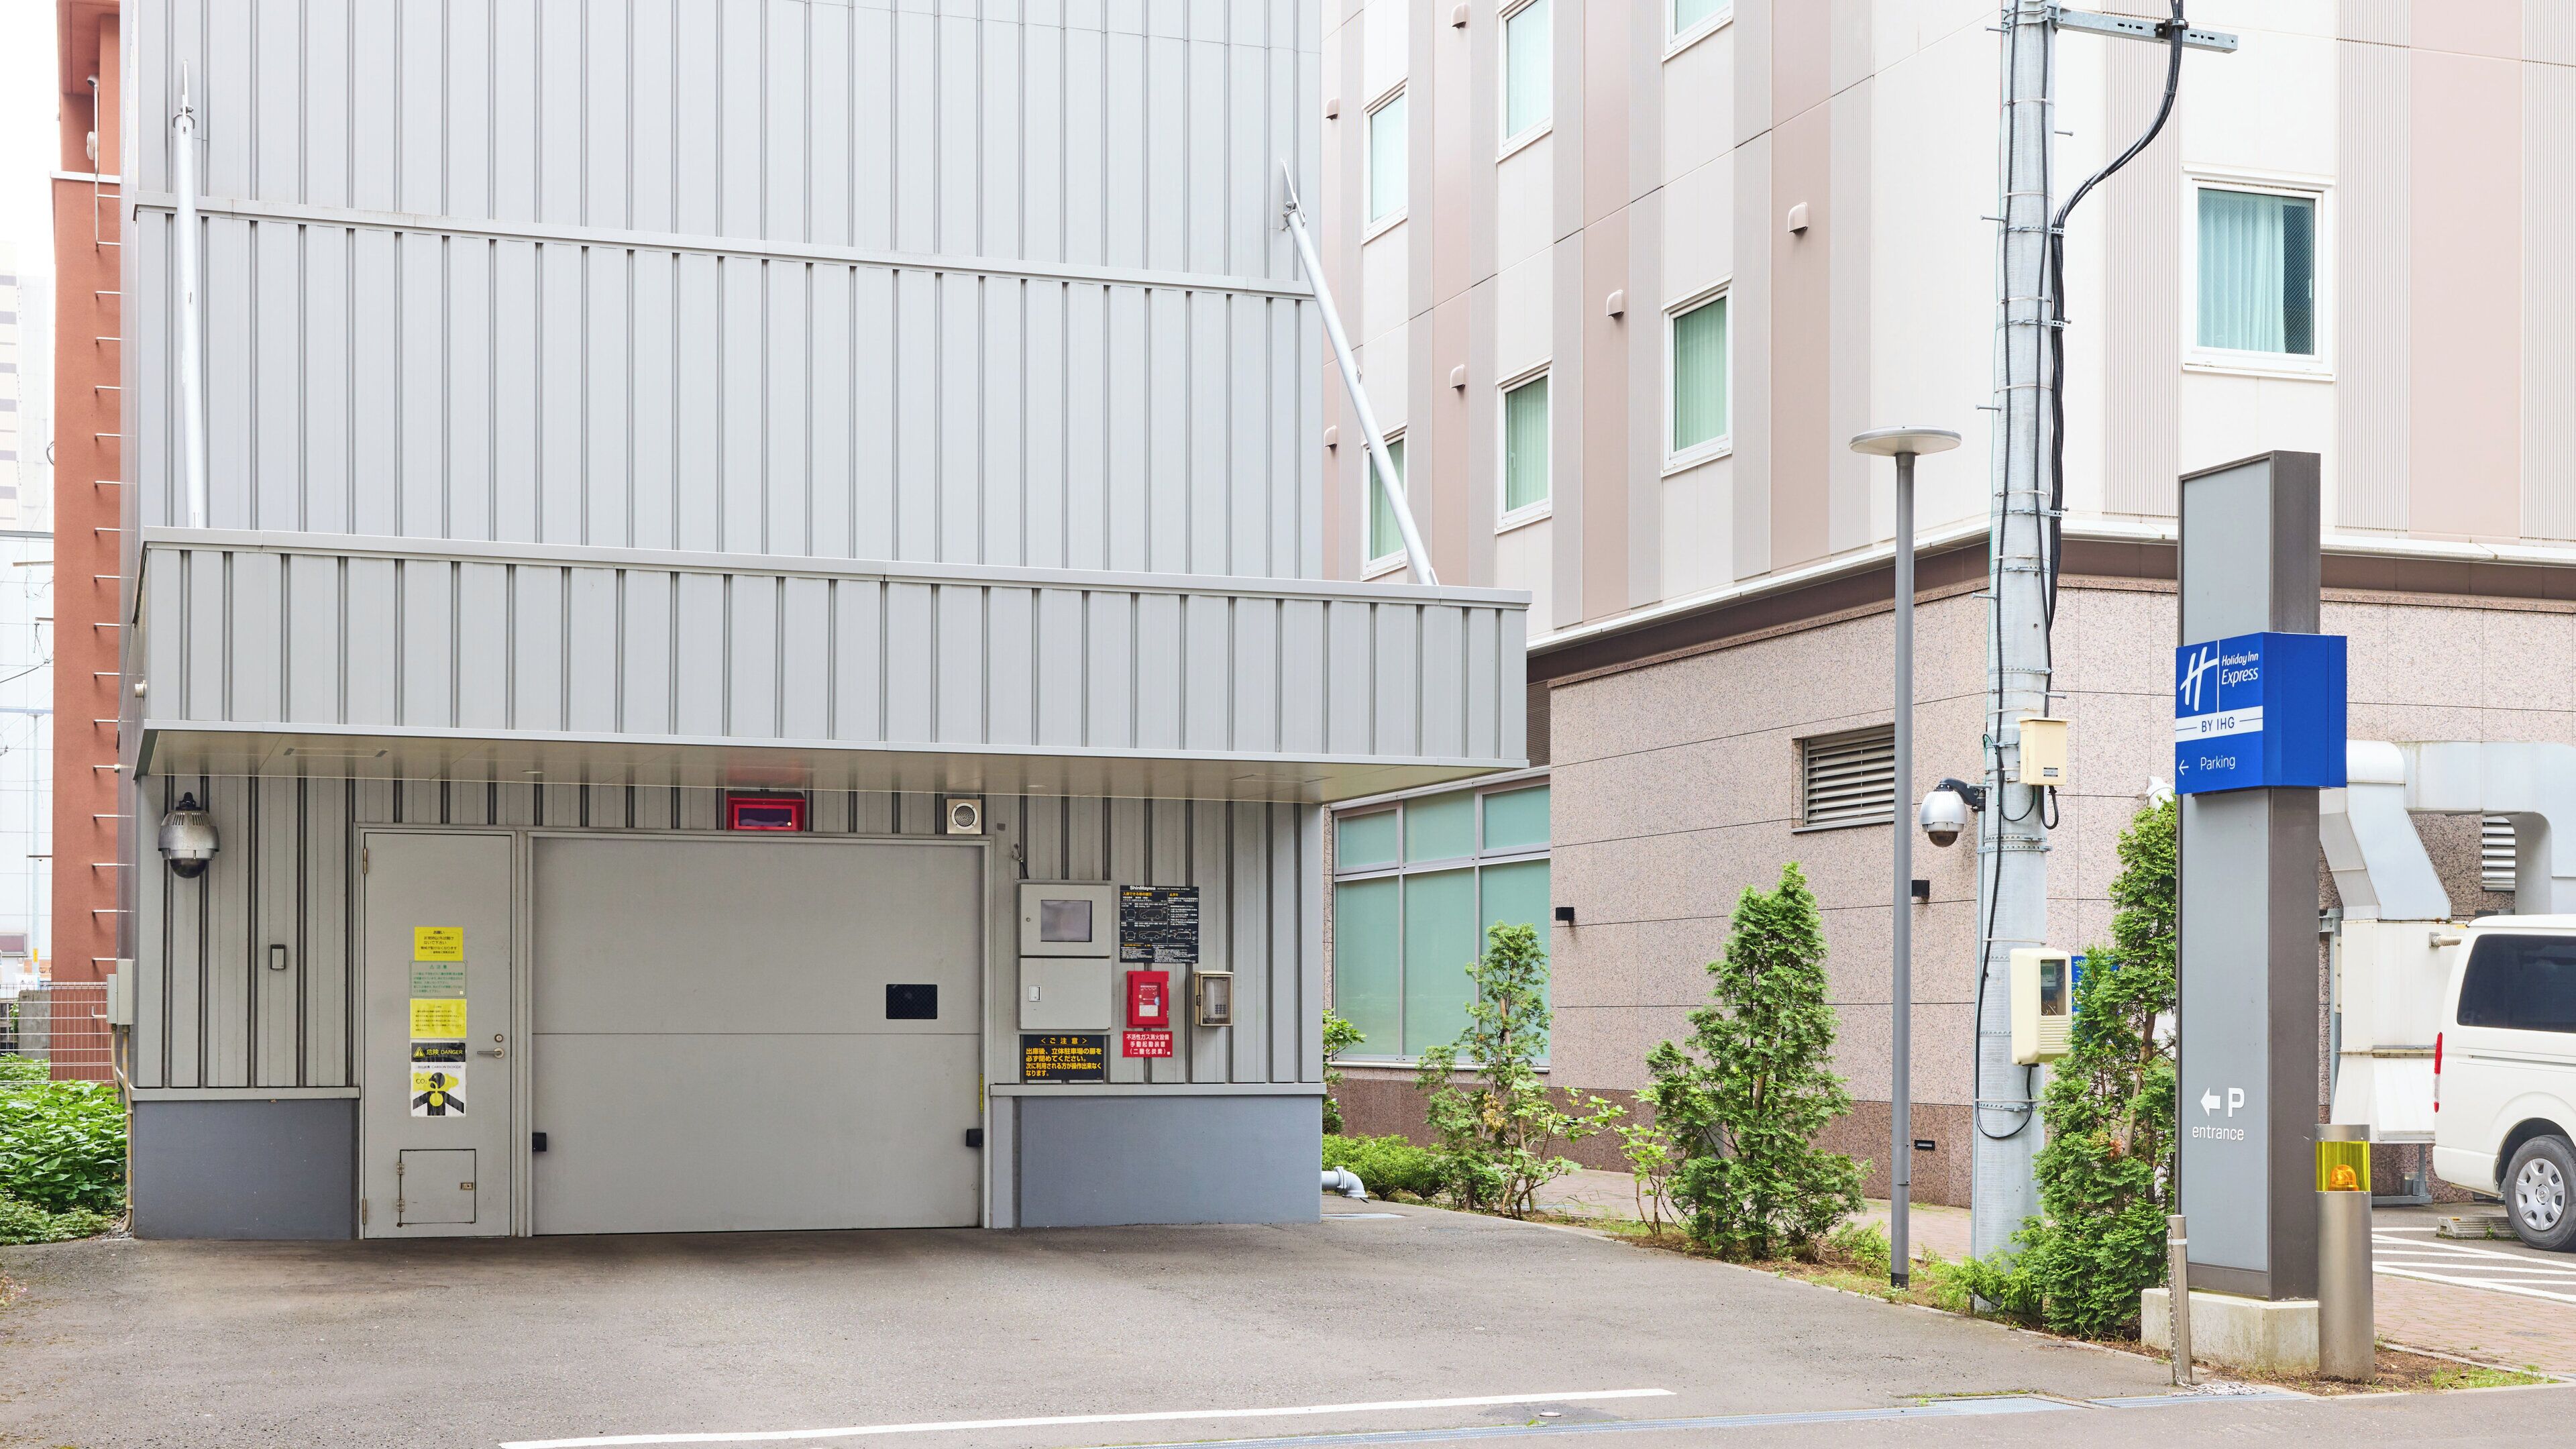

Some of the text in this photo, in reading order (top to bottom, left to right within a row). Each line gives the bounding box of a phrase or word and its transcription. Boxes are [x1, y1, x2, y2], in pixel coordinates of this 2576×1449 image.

[2221, 651, 2259, 667] Holiday Inn
[2221, 667, 2259, 688] Express
[2202, 716, 2235, 733] BY IHG
[2200, 755, 2235, 771] Parking
[2228, 1087, 2245, 1118] P
[2192, 1125, 2245, 1141] entrance
